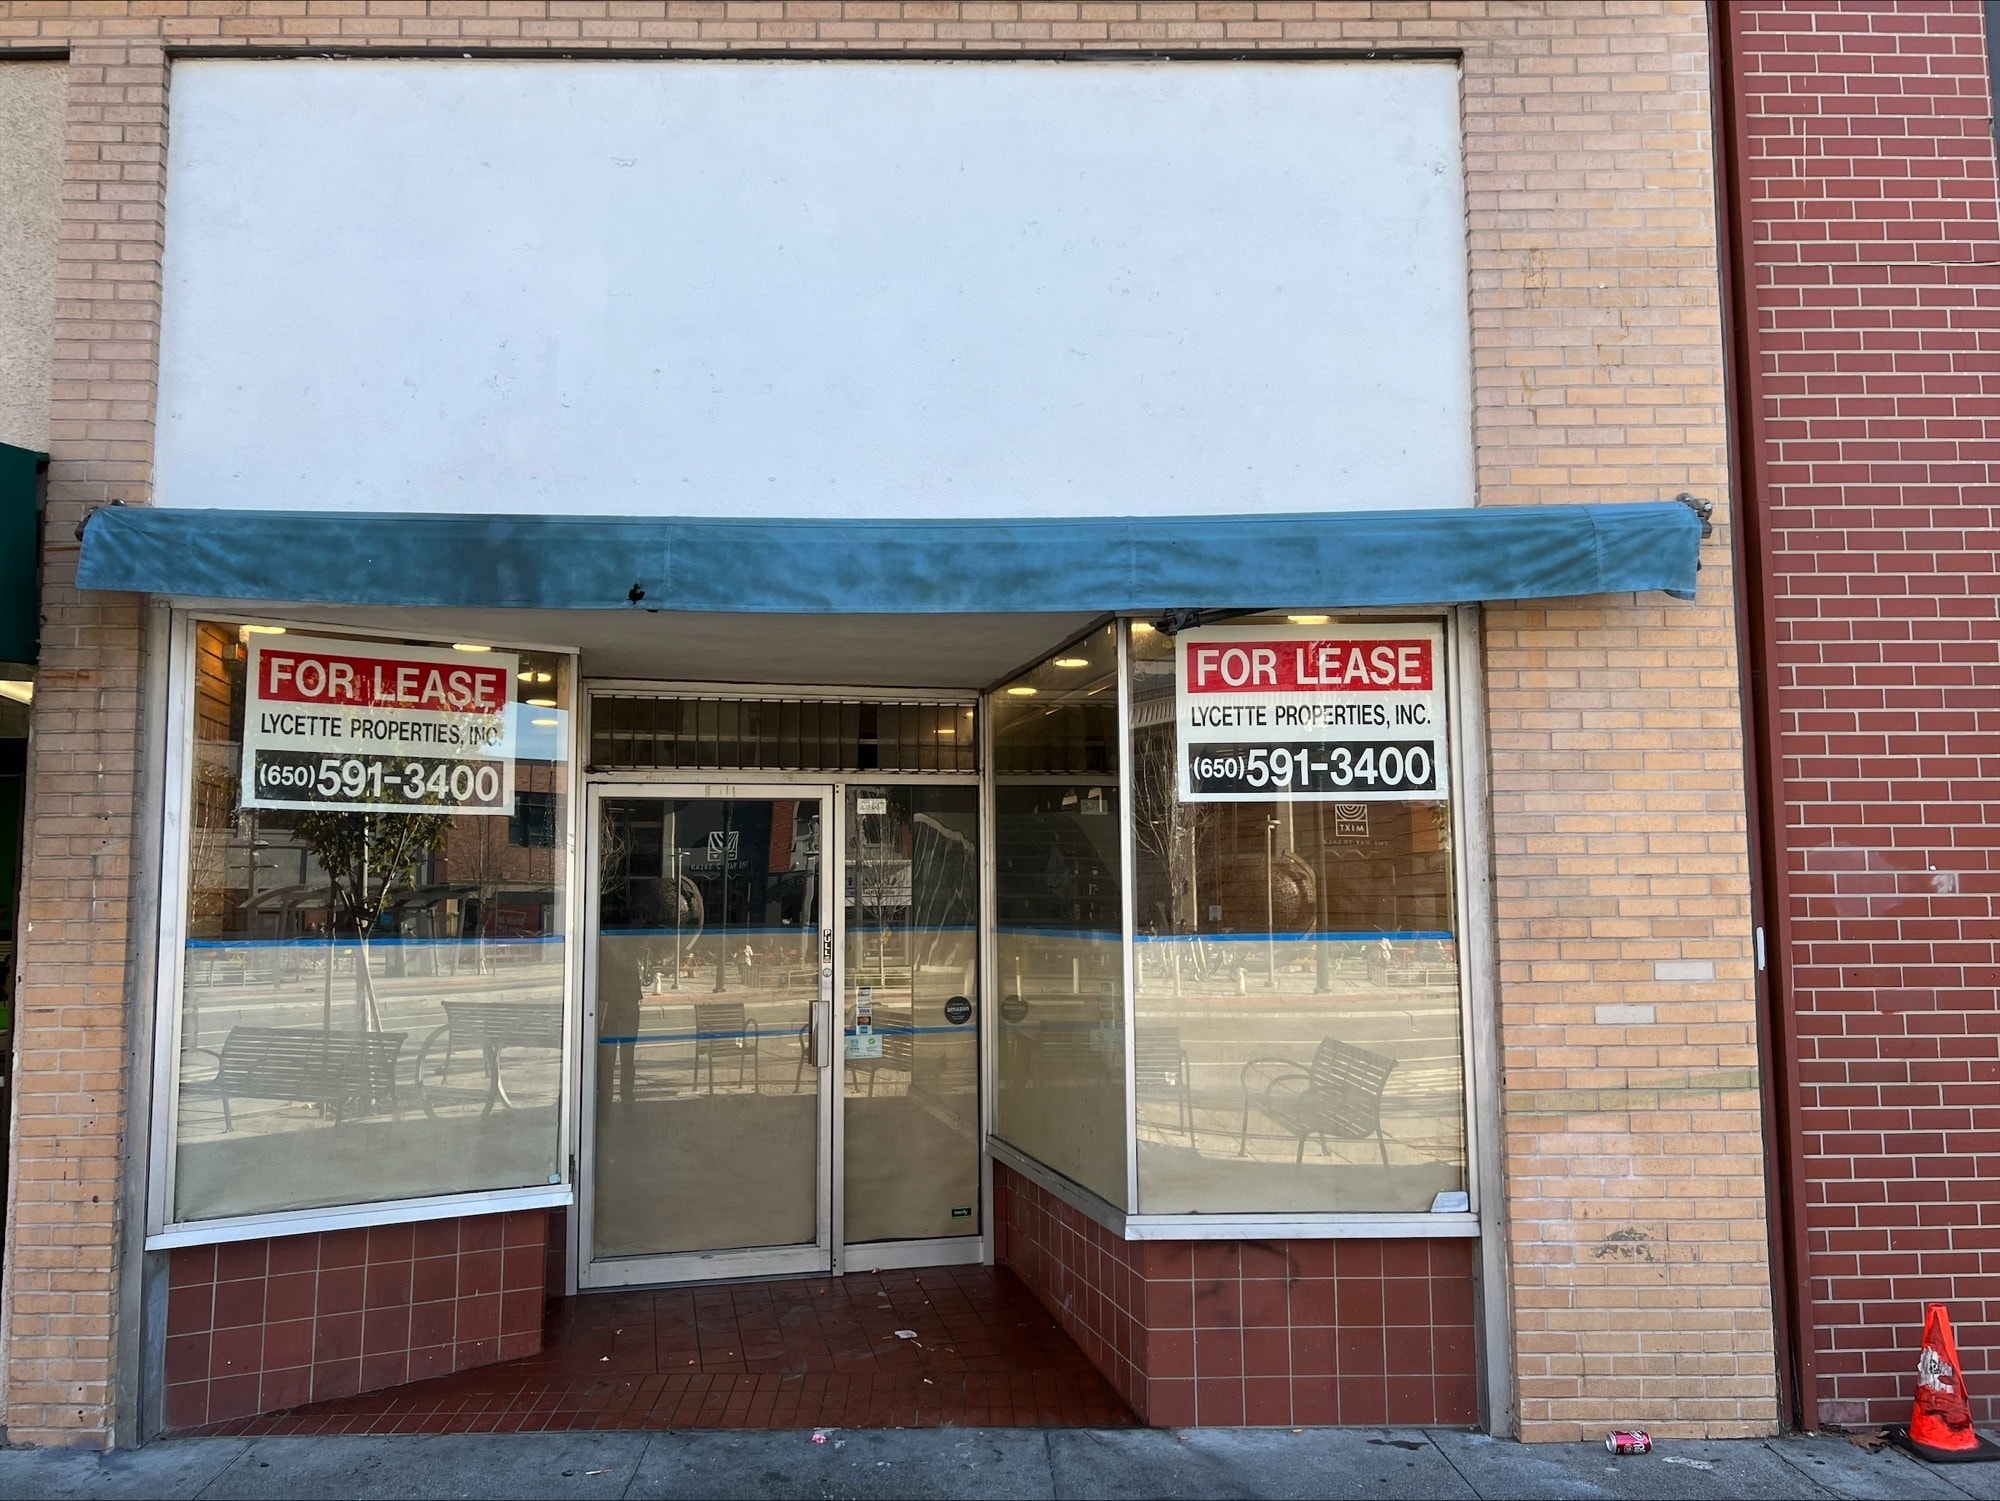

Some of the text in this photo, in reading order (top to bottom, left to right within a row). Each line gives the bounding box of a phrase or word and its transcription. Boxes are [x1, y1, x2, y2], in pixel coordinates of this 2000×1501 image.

[270, 657, 497, 709] FOR LEASE
[1197, 646, 1422, 687] FOR LEASE
[261, 713, 342, 737] LYCETTE
[351, 718, 464, 747] PROPERTIES,
[1191, 703, 1431, 730] LYCETTE PROPERTIES, INC.
